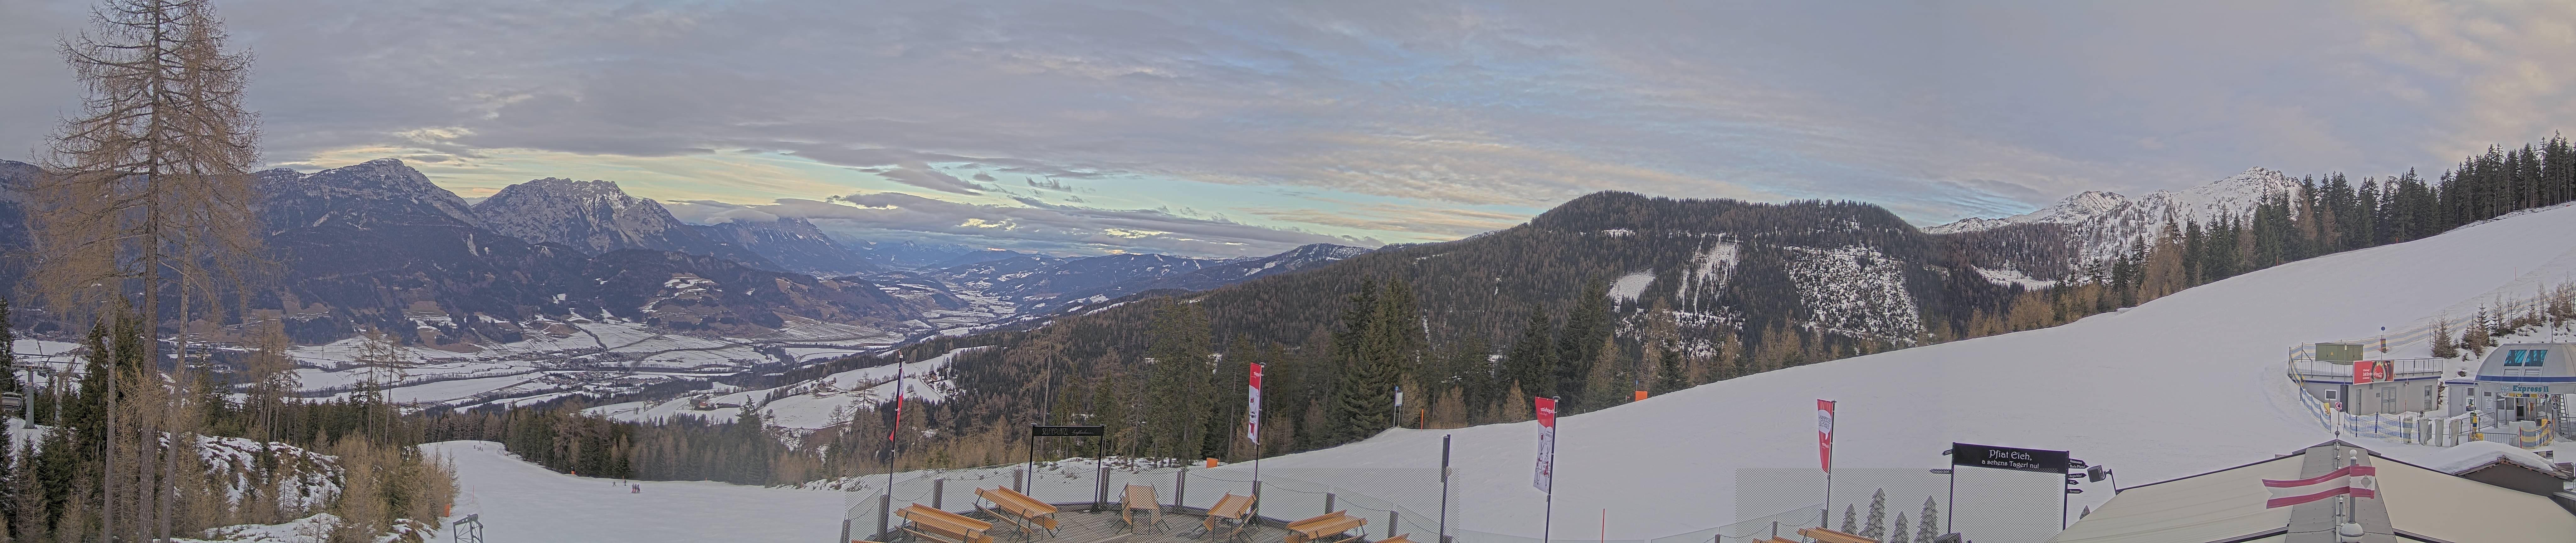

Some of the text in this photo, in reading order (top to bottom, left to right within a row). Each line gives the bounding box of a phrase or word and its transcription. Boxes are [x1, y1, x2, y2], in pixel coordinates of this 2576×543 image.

[2373, 369, 2383, 378] Coca-Cola
[1989, 450, 2032, 461] Pfiat Eich,
